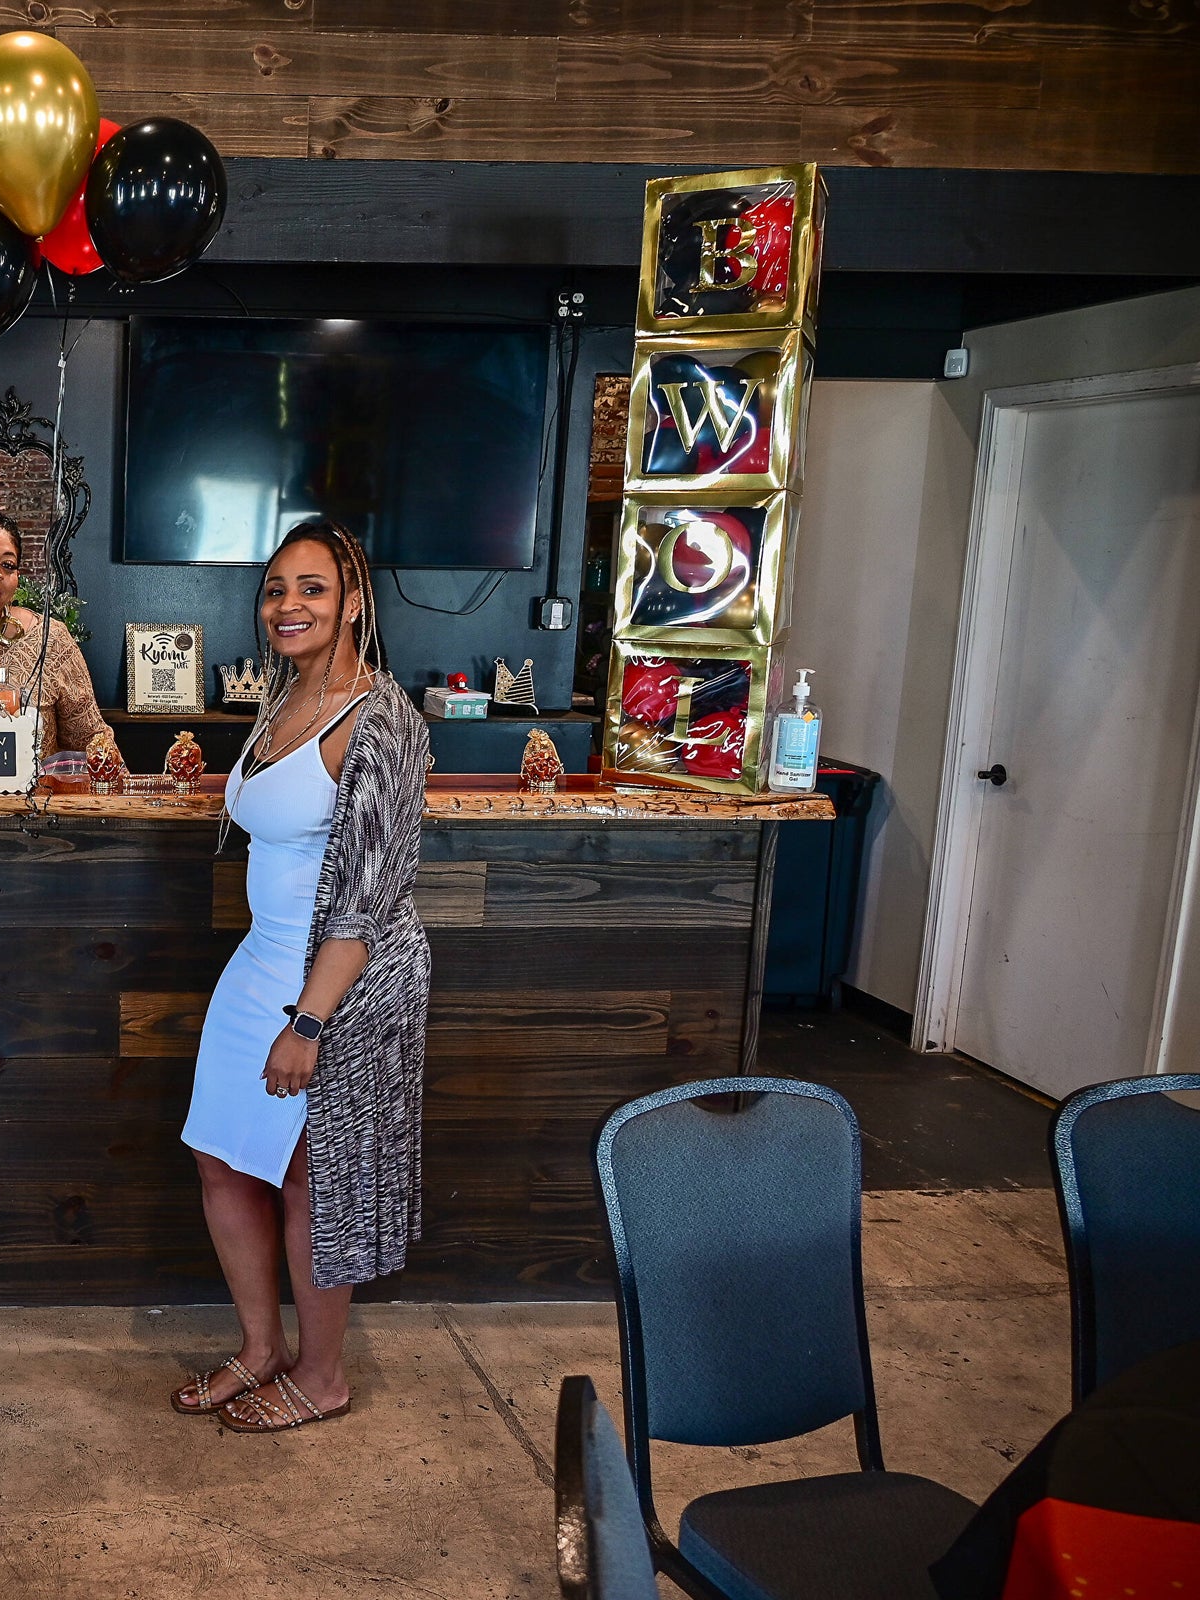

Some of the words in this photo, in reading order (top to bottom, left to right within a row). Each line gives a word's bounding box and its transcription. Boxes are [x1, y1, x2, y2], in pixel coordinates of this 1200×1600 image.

[689, 217, 758, 293] B
[657, 377, 765, 455] W
[658, 520, 734, 594] O
[663, 676, 731, 746] L
